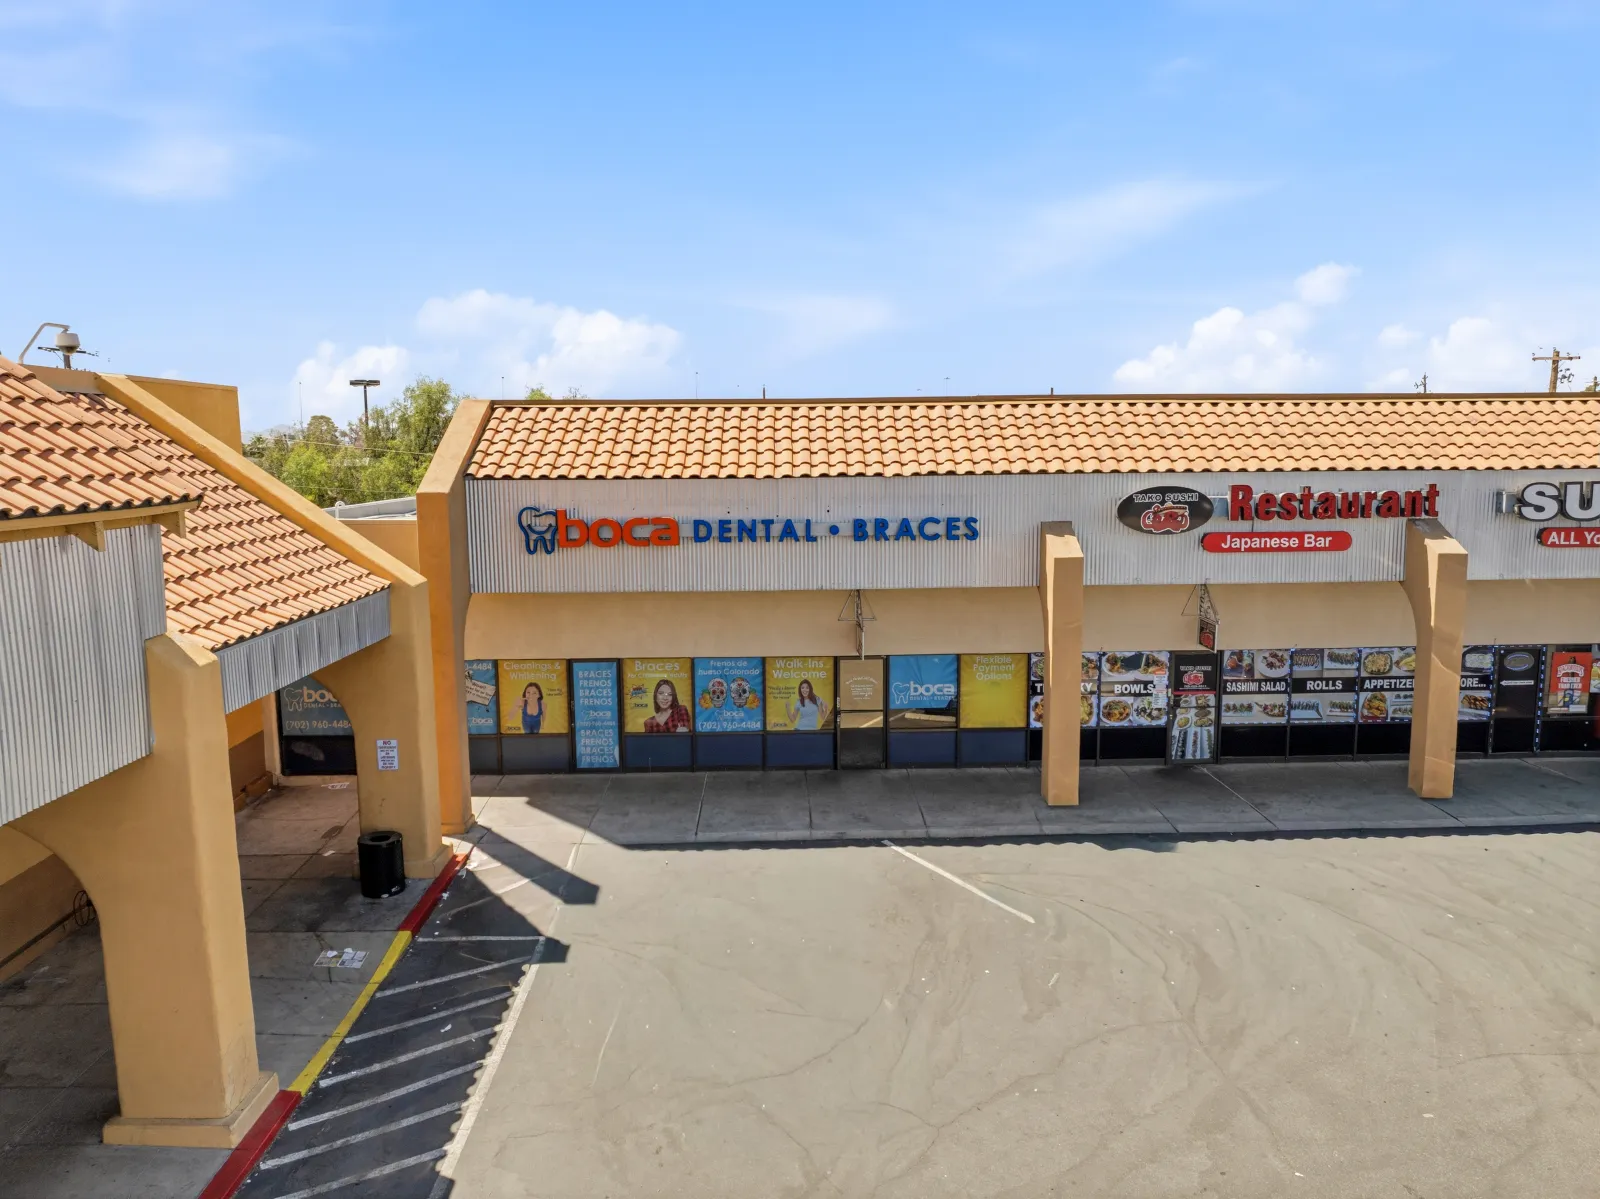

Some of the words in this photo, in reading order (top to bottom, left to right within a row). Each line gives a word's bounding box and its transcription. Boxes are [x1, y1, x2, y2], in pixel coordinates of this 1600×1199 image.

[1133, 493, 1162, 502] TAKO
[1165, 492, 1199, 501] SUSHI
[1520, 481, 1600, 522] SU
[1228, 484, 1438, 521] Restaurant
[557, 509, 680, 548] boca
[694, 518, 817, 543] DENTAL
[853, 516, 979, 542] BRACES
[1220, 534, 1299, 551] Japanese
[1303, 534, 1333, 548] Bar
[1547, 531, 1580, 545] ALL
[710, 659, 735, 667] Frenos
[737, 659, 748, 667] de
[775, 658, 824, 669] Walk-Ins
[976, 655, 1012, 664] Flexible
[504, 661, 552, 672] Cleanings
[554, 661, 561, 670] &
[635, 660, 680, 671] Braces
[973, 663, 1015, 673] Payment
[509, 671, 557, 682] Whitening
[578, 670, 612, 678] BRACES
[724, 667, 760, 676] Colorado
[772, 669, 827, 679] Welcome
[975, 672, 1013, 682] Options
[579, 679, 612, 687] FRENOS
[1226, 682, 1259, 692] SASHIMI
[1260, 681, 1286, 691] SALAD
[1306, 680, 1343, 691] ROLLS
[579, 688, 612, 696] BRACES
[909, 681, 955, 696] boca
[1114, 684, 1154, 694] BOWLS
[580, 697, 612, 705] FRENOS
[589, 710, 611, 718] boca
[286, 720, 309, 730] (702)
[699, 720, 720, 730] (702)
[723, 720, 760, 729] 960-4484
[580, 729, 613, 737] BRACES
[581, 738, 614, 746] FRENOS
[582, 755, 615, 763] FRENOS
